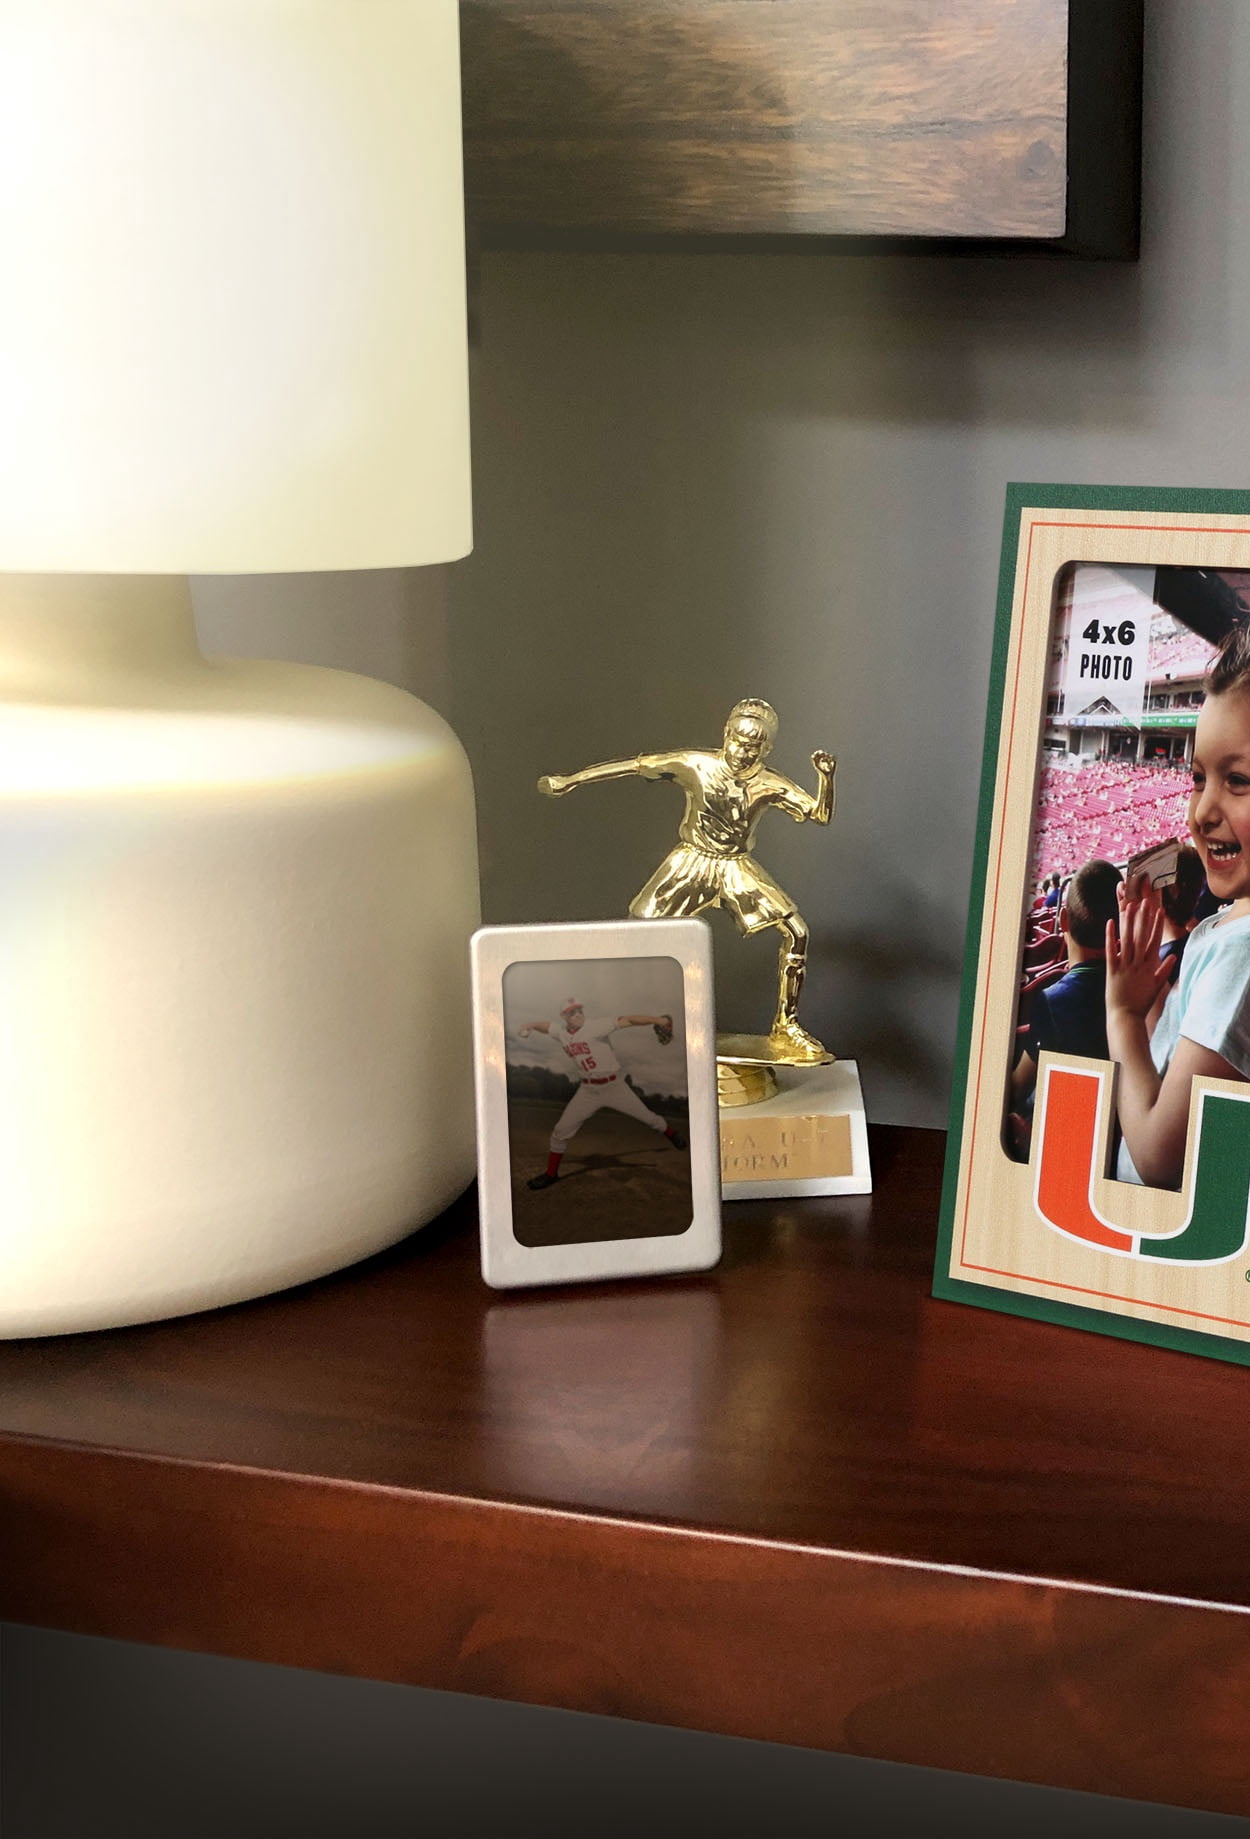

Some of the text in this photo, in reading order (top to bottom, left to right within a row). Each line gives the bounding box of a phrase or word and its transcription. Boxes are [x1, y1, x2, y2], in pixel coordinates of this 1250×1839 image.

[1082, 618, 1136, 646] 4x6
[1079, 653, 1133, 681] PHOTO
[581, 1056, 597, 1072] 15
